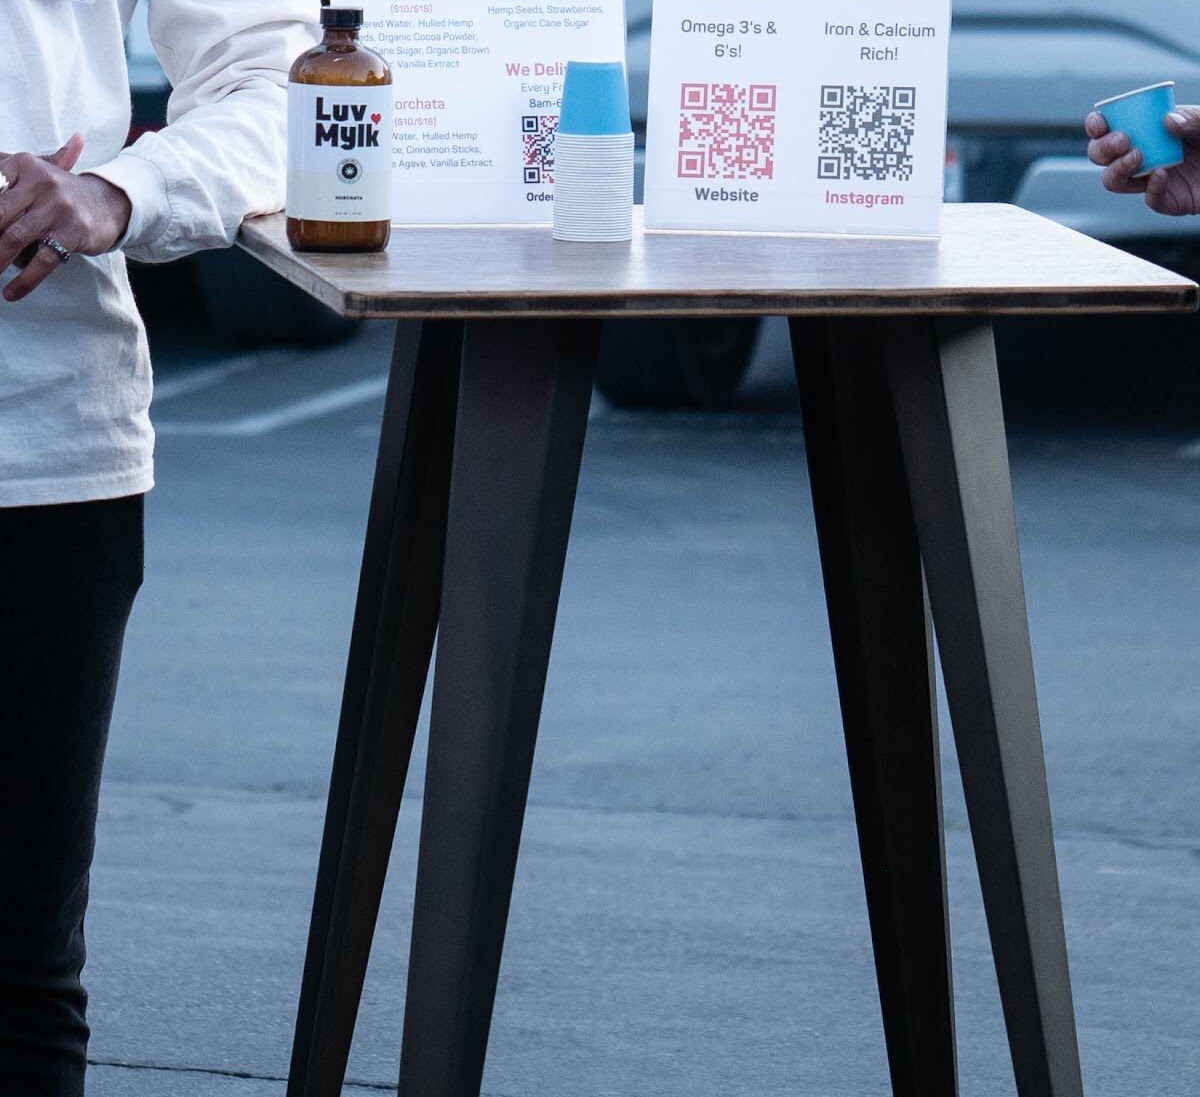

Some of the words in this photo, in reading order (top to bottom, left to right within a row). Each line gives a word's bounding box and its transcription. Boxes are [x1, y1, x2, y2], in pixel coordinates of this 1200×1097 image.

[488, 6, 514, 15] Hemp
[418, 19, 446, 28] Hulled
[448, 19, 474, 29] Hemp
[504, 19, 537, 29] Organic
[539, 19, 562, 28] Cane
[564, 19, 589, 29] Sugar
[681, 19, 735, 36] Omega
[738, 20, 762, 34] 3's
[766, 20, 777, 35] &
[824, 22, 854, 36] Iron
[858, 23, 870, 36] &
[874, 22, 935, 38] Calcium
[378, 33, 412, 43] Organic
[413, 33, 442, 42] Cocoa
[443, 32, 478, 42] Powder,
[396, 46, 424, 56] Sugar,
[426, 46, 459, 56] Organic
[461, 46, 490, 54] Brown
[714, 44, 742, 58] 6's!
[860, 46, 898, 60] Rich!
[397, 60, 426, 68] Vanilla
[428, 60, 460, 68] Extract
[505, 62, 530, 76] We
[520, 82, 550, 94] Every
[316, 96, 368, 122] Luv
[395, 98, 445, 110] orchata
[314, 122, 380, 150] Mylk
[422, 131, 450, 140] Hulled
[452, 132, 478, 141] Hemp
[406, 145, 450, 154] Cinnamon
[452, 145, 481, 154] Sticks,
[398, 160, 428, 170] Agave,
[430, 159, 458, 168] Vanilla
[460, 158, 493, 167] Extract
[694, 187, 759, 202] Website
[825, 190, 904, 208] Instagram
